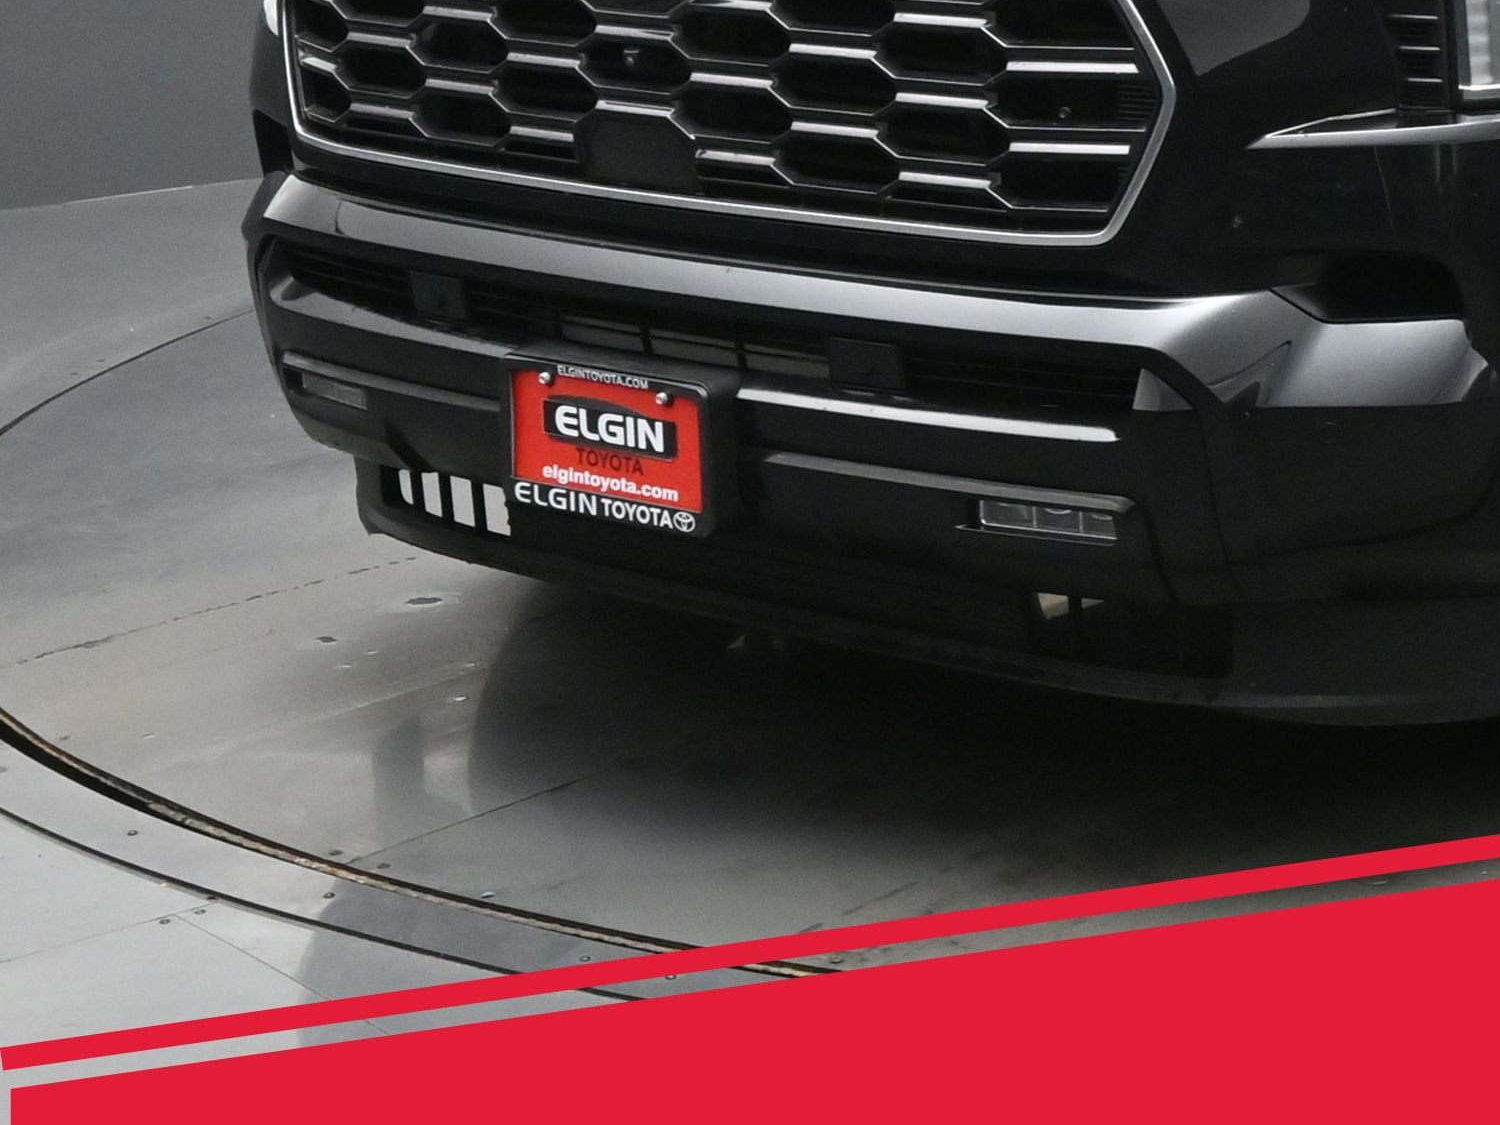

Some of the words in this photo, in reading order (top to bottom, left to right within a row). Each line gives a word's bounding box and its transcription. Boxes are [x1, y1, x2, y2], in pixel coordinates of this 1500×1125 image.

[557, 365, 649, 389] ELGINTOYOTA.COM
[554, 404, 665, 453] ELGIN
[575, 447, 644, 475] TOYOTA
[542, 463, 679, 502] elgintoyota.com
[514, 481, 598, 516] ELGIN
[600, 498, 673, 530] TOYOTA
